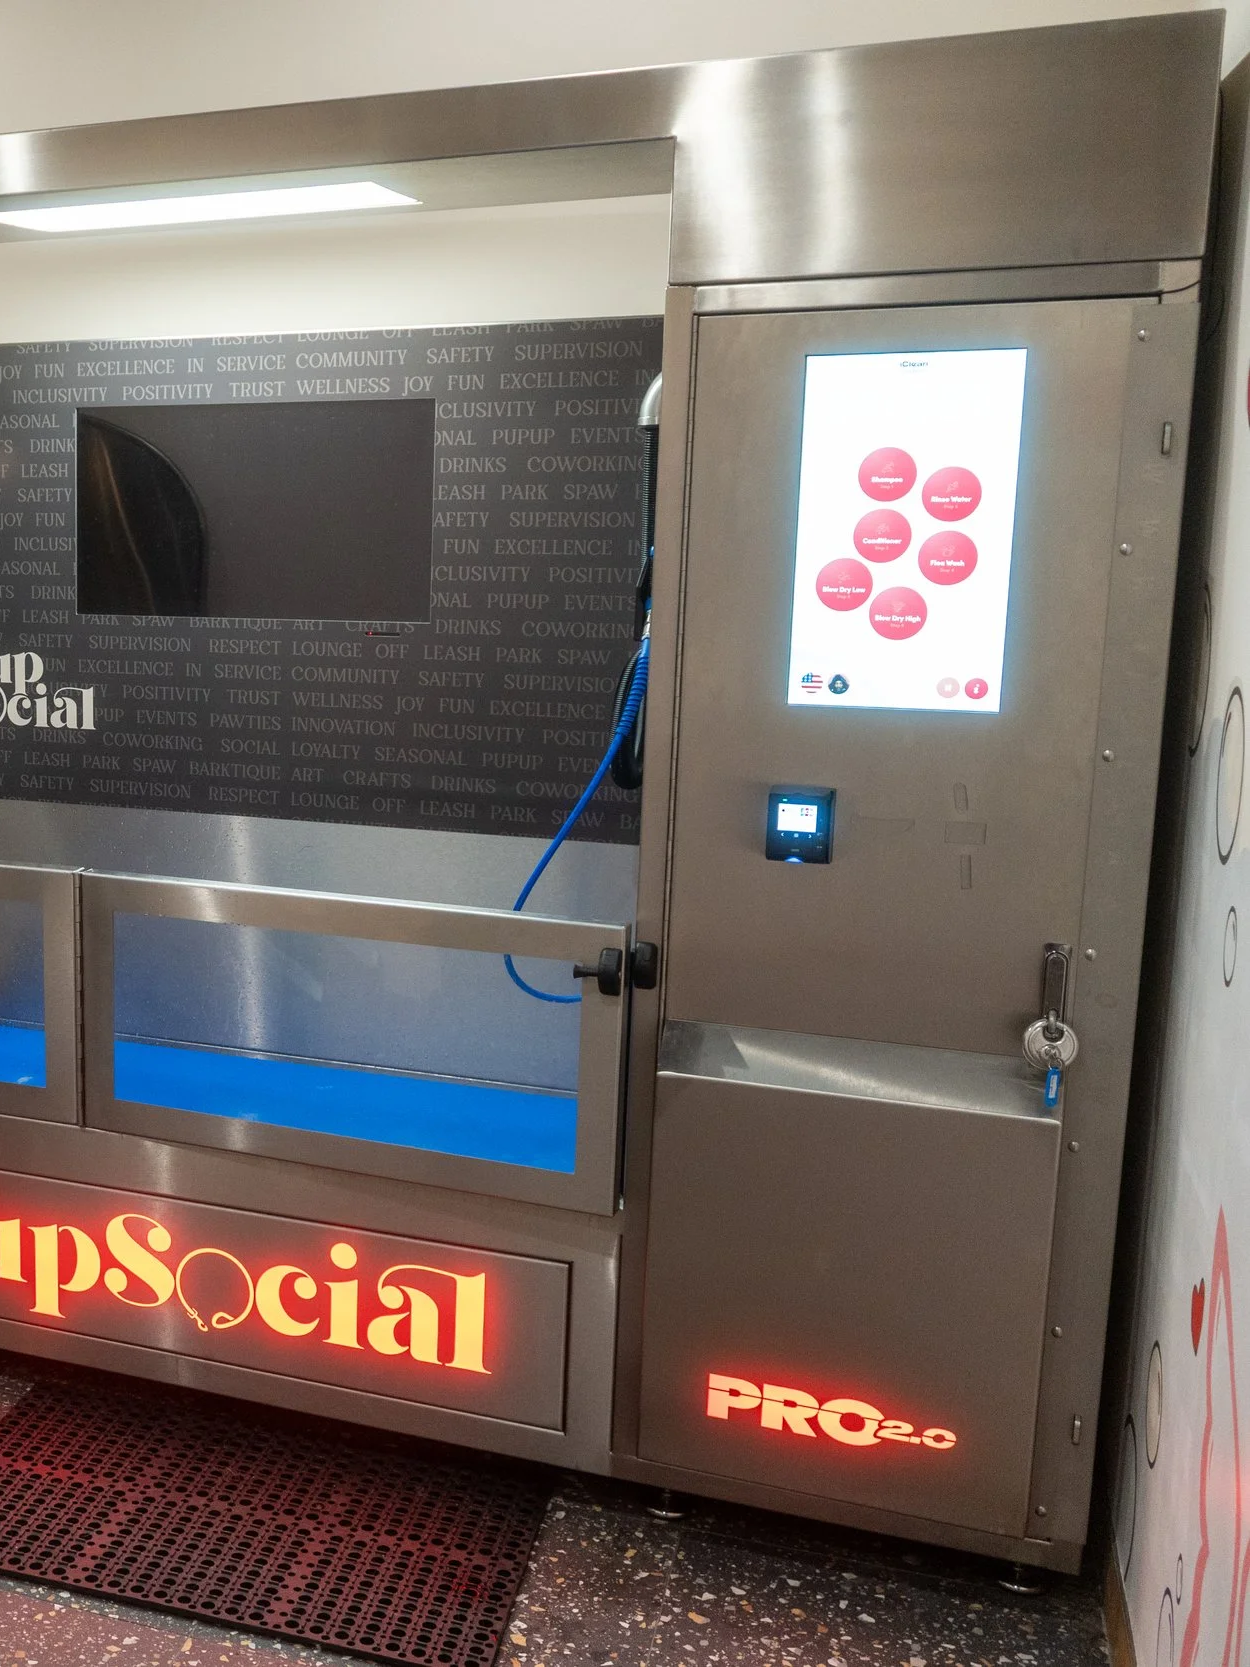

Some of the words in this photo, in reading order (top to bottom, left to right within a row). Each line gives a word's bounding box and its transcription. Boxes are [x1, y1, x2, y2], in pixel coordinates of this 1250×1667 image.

[34, 362, 65, 378] FUN
[77, 358, 176, 377] EXCELLENCE
[187, 357, 205, 373] IN
[216, 354, 287, 372] SERVICE
[296, 349, 408, 369] COMMUNITY
[426, 345, 495, 364] SAFETY
[514, 340, 643, 361] SUPERVISION
[13, 386, 108, 404] INCLUSIVITY
[122, 383, 214, 401] POSITIVITY
[229, 380, 287, 398] TRUST
[296, 377, 391, 396] WELLNESS
[401, 375, 434, 396] JOY
[447, 374, 486, 391] FUN
[500, 370, 619, 390] EXCELLENCE
[492, 428, 556, 446] PUPUP
[570, 426, 645, 444] EVENTS
[21, 462, 69, 478] LEASH
[439, 456, 507, 473] DRINKS
[17, 487, 73, 503] SAFETY
[501, 484, 549, 501] PARK
[563, 483, 618, 501] SPAW
[35, 512, 66, 527] FUN
[509, 511, 636, 528] SUPERVISION
[443, 538, 480, 555] FUN
[494, 538, 613, 556] EXCELLENCE
[487, 592, 550, 610] PUPUP
[22, 609, 70, 625] LEASH
[81, 614, 120, 626] PARK
[132, 615, 175, 628] SPAW
[189, 617, 283, 632] BARKTIQUE
[435, 618, 502, 637] DRINKS
[89, 634, 192, 652] SUPERVISION
[208, 638, 283, 656] RESPECT
[291, 640, 363, 659] LOUNGE
[374, 643, 410, 660] OFF
[423, 643, 482, 662] LEASH
[185, 662, 202, 677] IN
[214, 662, 282, 681] SERVICE
[291, 665, 401, 685] COMMUNITY
[417, 670, 486, 689] SAFETY
[122, 684, 211, 703] POSITIVITY
[226, 688, 282, 706] TRUST
[394, 695, 426, 715] JOY
[439, 697, 476, 715] FUN
[209, 712, 282, 732] PAWTIES
[220, 737, 281, 756] SOCIAL
[374, 746, 468, 767] SEASONAL
[23, 750, 71, 768] LEASH
[82, 753, 121, 770] PARK
[132, 757, 177, 774] SPAW
[189, 760, 282, 782] BARKTIQUE
[291, 767, 325, 783] ART
[342, 769, 412, 789] CRAFTS
[431, 774, 497, 794] DRINKS
[420, 799, 476, 819] LEASH
